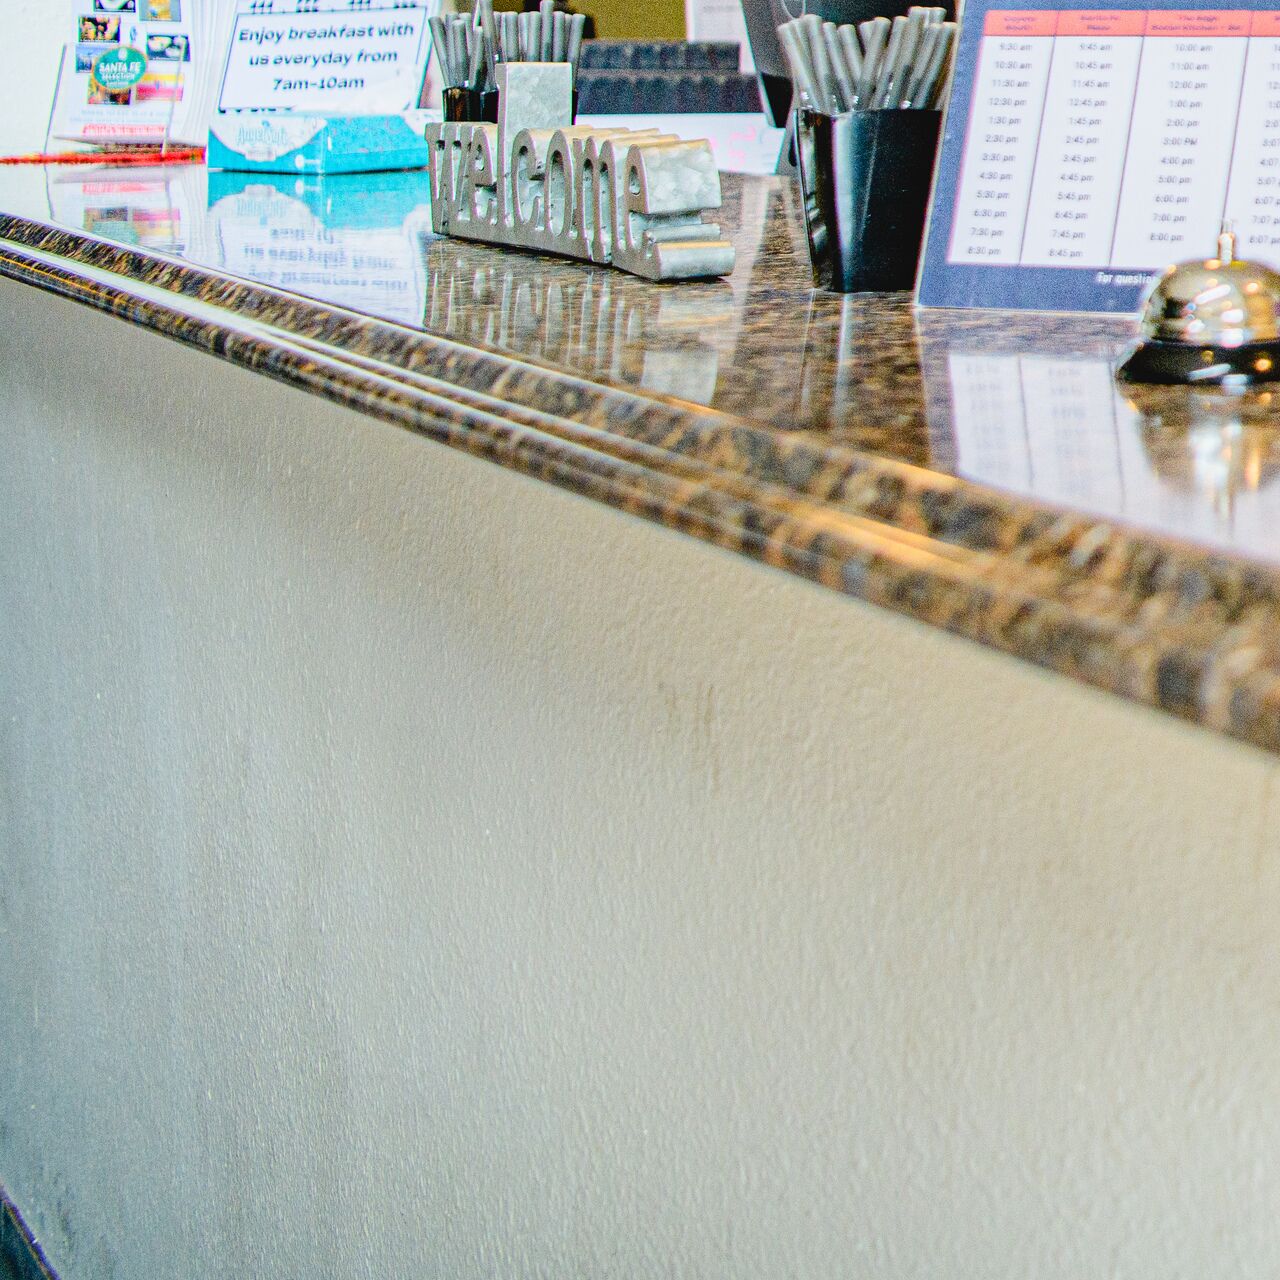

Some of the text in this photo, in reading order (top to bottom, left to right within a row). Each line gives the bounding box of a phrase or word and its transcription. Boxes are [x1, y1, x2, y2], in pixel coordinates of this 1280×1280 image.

[239, 22, 414, 45] Enjoy breakfast with
[99, 61, 141, 72] SANTA FE
[249, 49, 398, 68] us everyday from
